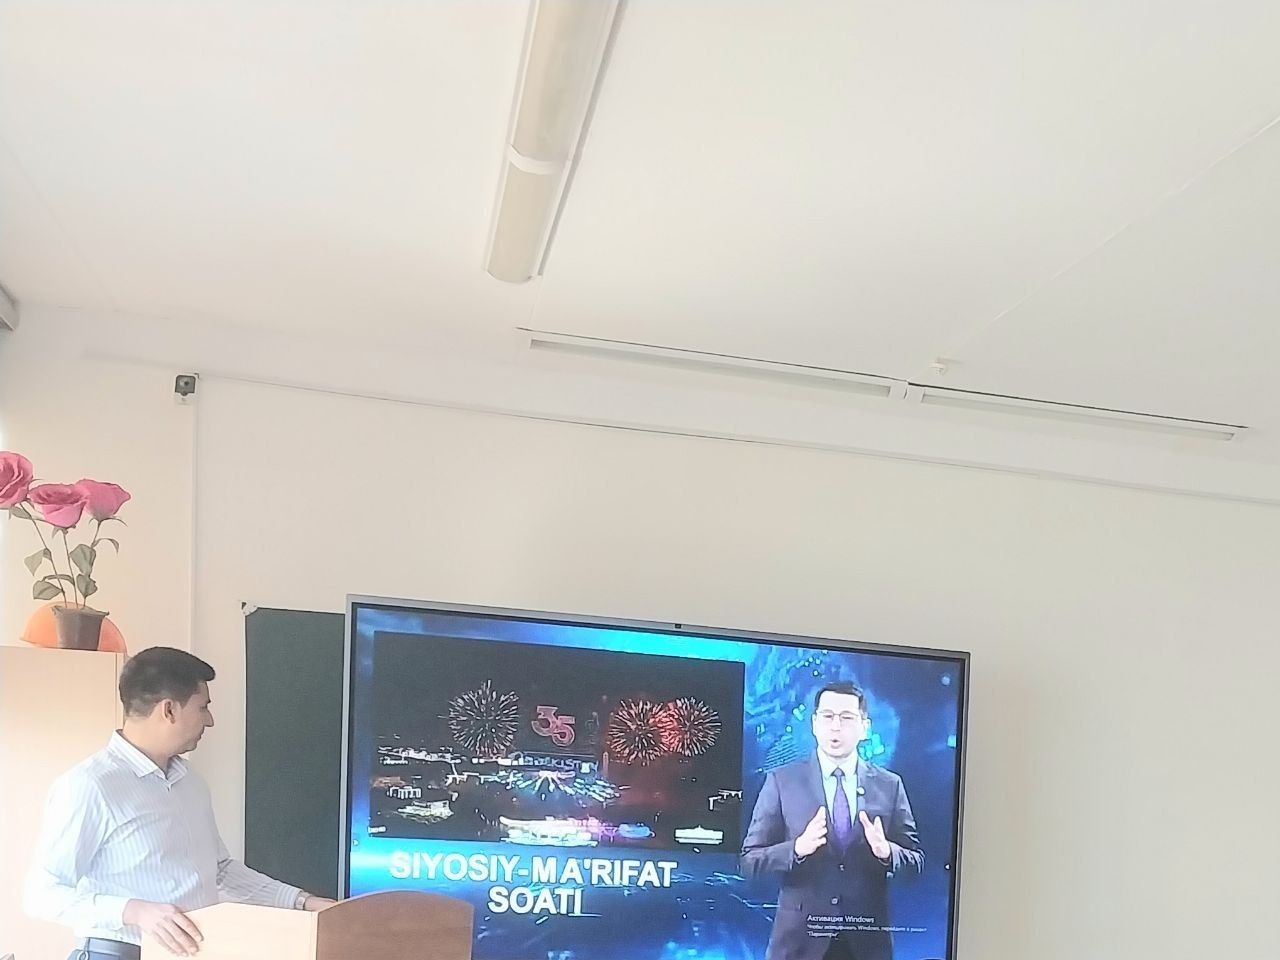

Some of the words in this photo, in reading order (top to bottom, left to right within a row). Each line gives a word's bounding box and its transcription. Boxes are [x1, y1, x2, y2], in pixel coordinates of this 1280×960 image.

[531, 705, 576, 747] 35
[389, 850, 678, 888] SIYOSIY-MA'RIFAT
[487, 886, 583, 915] SOATI
[844, 915, 875, 923] Windows
